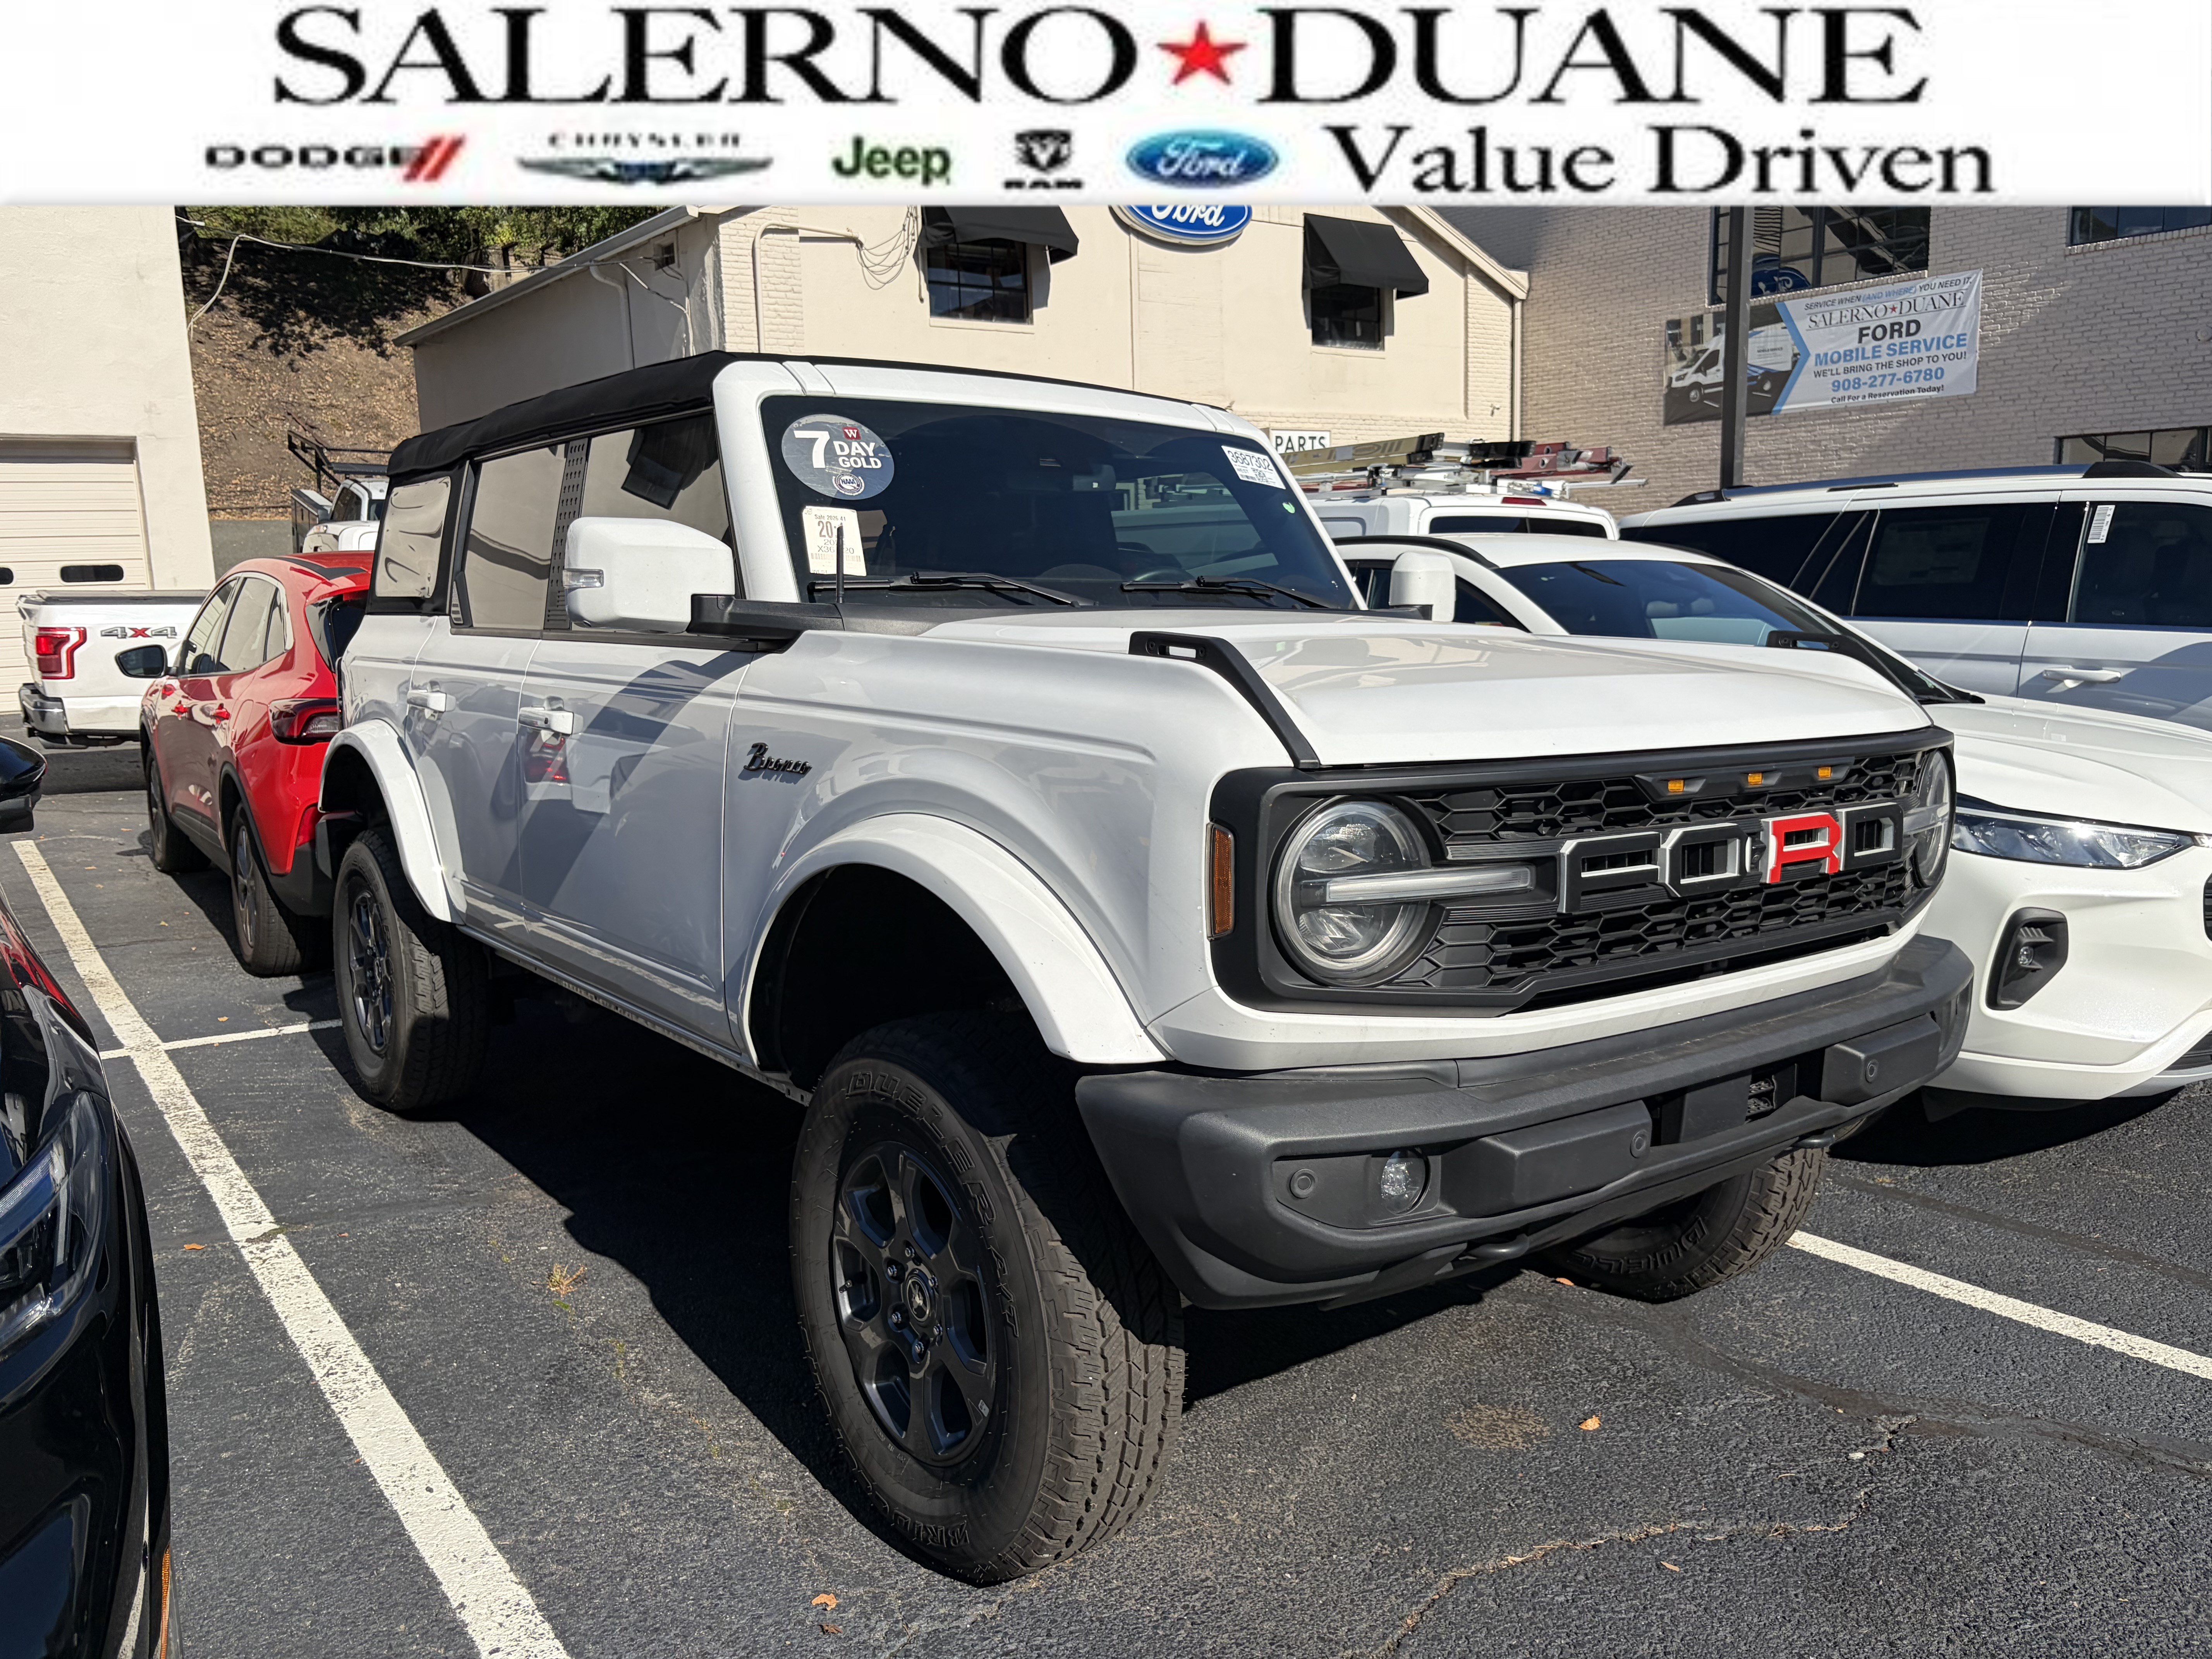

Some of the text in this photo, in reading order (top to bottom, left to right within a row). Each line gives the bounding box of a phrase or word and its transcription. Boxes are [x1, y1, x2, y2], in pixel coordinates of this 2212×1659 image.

[1804, 299, 1836, 310] SERVICE
[1838, 295, 1862, 305] WHEN
[1862, 292, 1882, 303] (AND
[1885, 286, 1917, 298] WHERE)
[1919, 282, 1937, 292] YOU
[1938, 278, 1961, 289] NEED
[1808, 291, 1965, 329] SALERNO DUANE
[1858, 319, 1921, 344] FORD
[1814, 333, 1967, 367] MOBILE SERVICE
[1814, 350, 1967, 378] WE'LL BRING THE SHOP TO YOU!
[1831, 366, 1945, 393] 908-277-6780
[1831, 395, 1846, 404] Call
[1847, 394, 1860, 402] For
[1868, 388, 1915, 400] Reservation
[1917, 384, 1945, 394] Today!
[793, 430, 876, 469] 7 DAY
[1275, 435, 1326, 453] PARTS
[838, 457, 882, 469] GOLD
[1227, 450, 1273, 471] 3687302
[817, 545, 855, 554] X3620
[743, 742, 813, 775] Bronco
[1557, 801, 1905, 914] FORD
